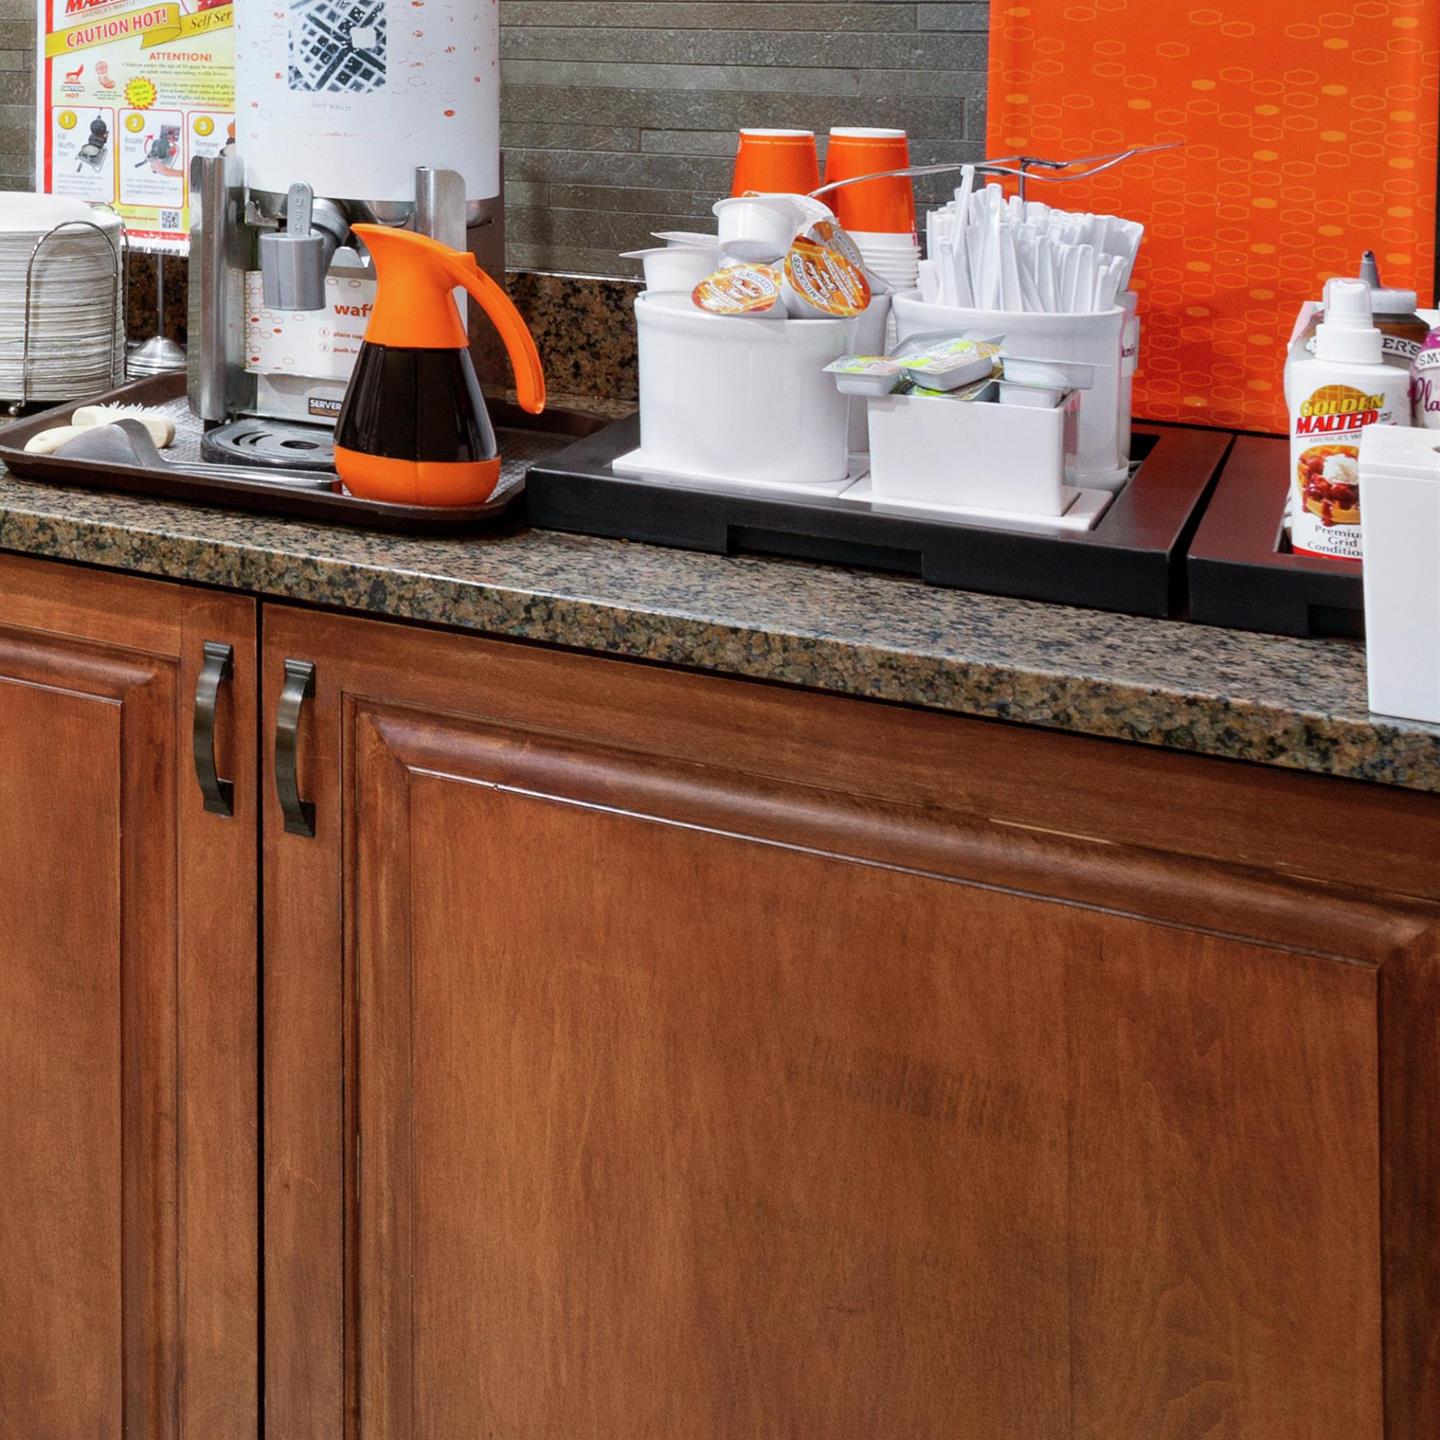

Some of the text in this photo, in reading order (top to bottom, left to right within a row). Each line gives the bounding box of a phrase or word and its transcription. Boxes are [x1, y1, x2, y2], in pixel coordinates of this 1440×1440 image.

[66, 9, 167, 48] CAUTION HOT!
[190, 14, 213, 29] Self
[149, 52, 212, 62] ATTENTION!
[310, 399, 342, 411] SERVER
[1300, 392, 1386, 417] GOLDEN
[1296, 410, 1379, 435] MALTED
[1327, 536, 1358, 548] Grid
